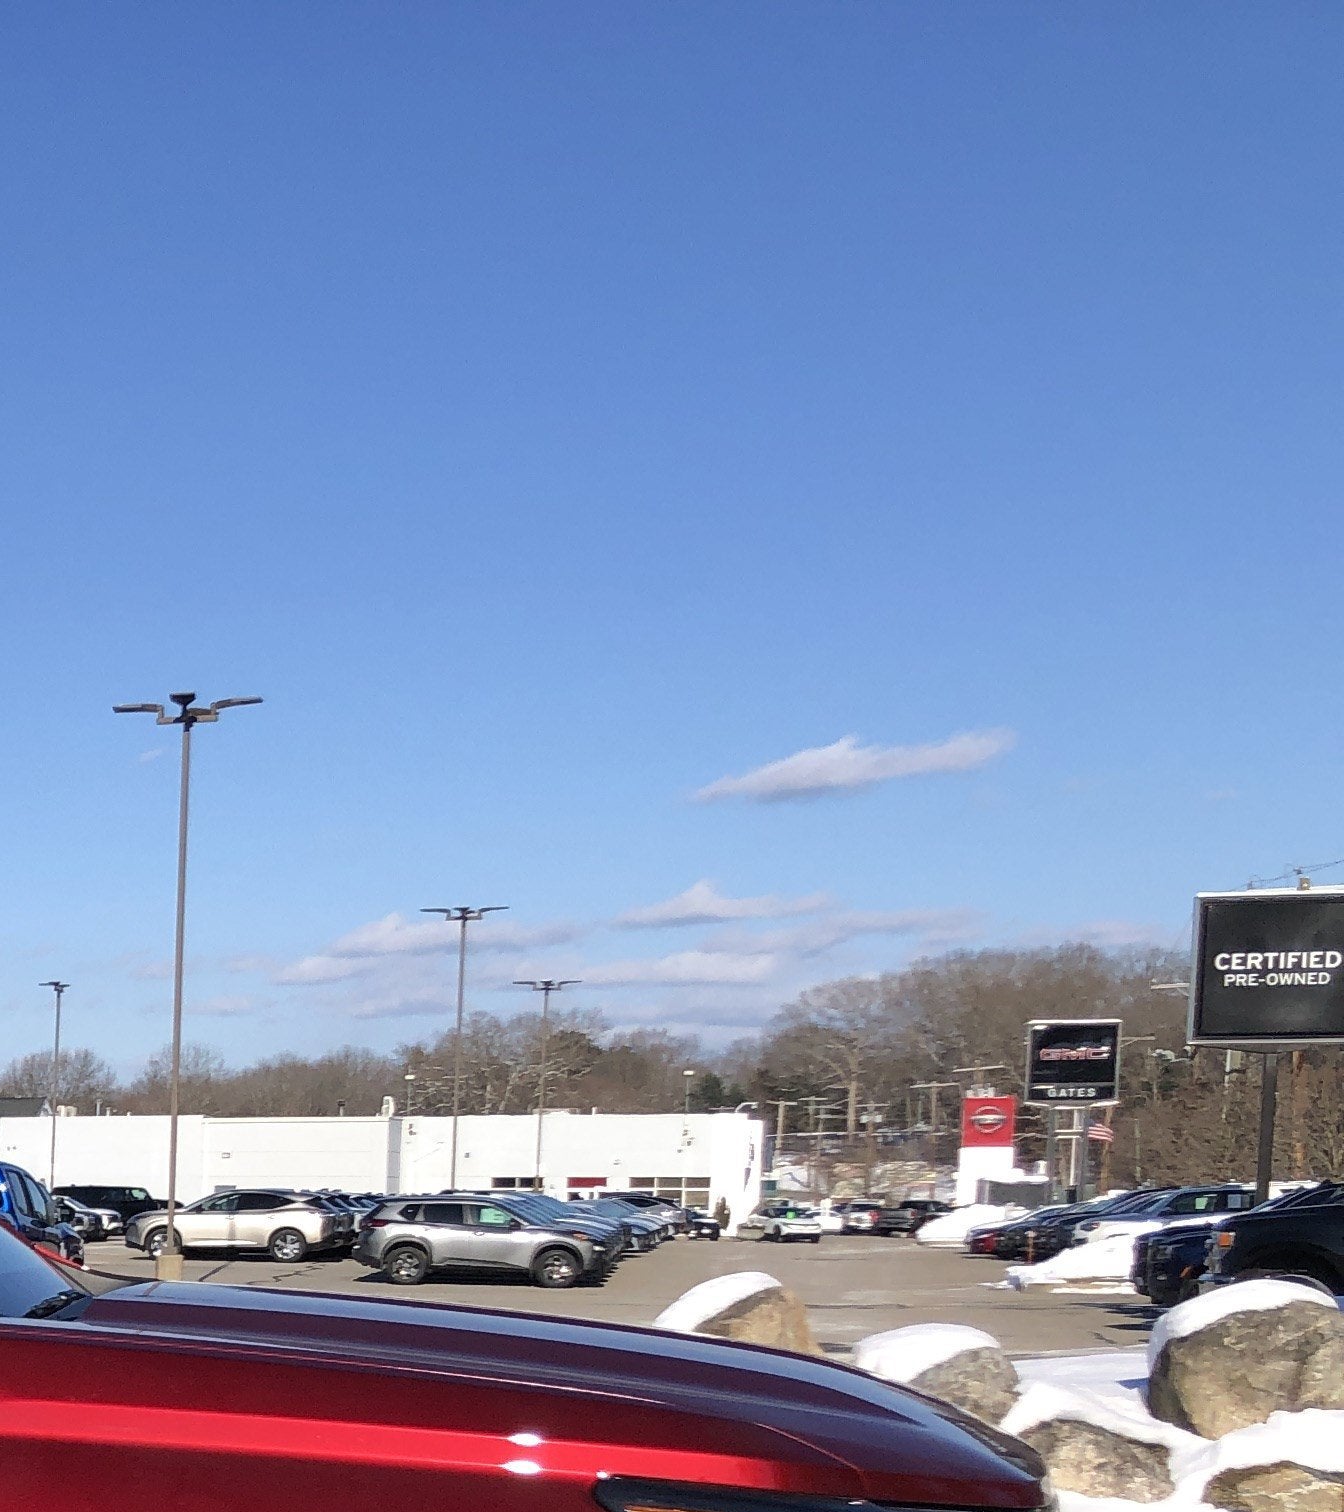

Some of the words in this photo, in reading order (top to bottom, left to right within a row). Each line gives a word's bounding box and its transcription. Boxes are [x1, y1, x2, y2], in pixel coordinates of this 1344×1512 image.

[1214, 950, 1343, 970] CERTIFIED
[1223, 972, 1331, 987] PRE-OWNED
[1048, 1088, 1096, 1098] GATES
